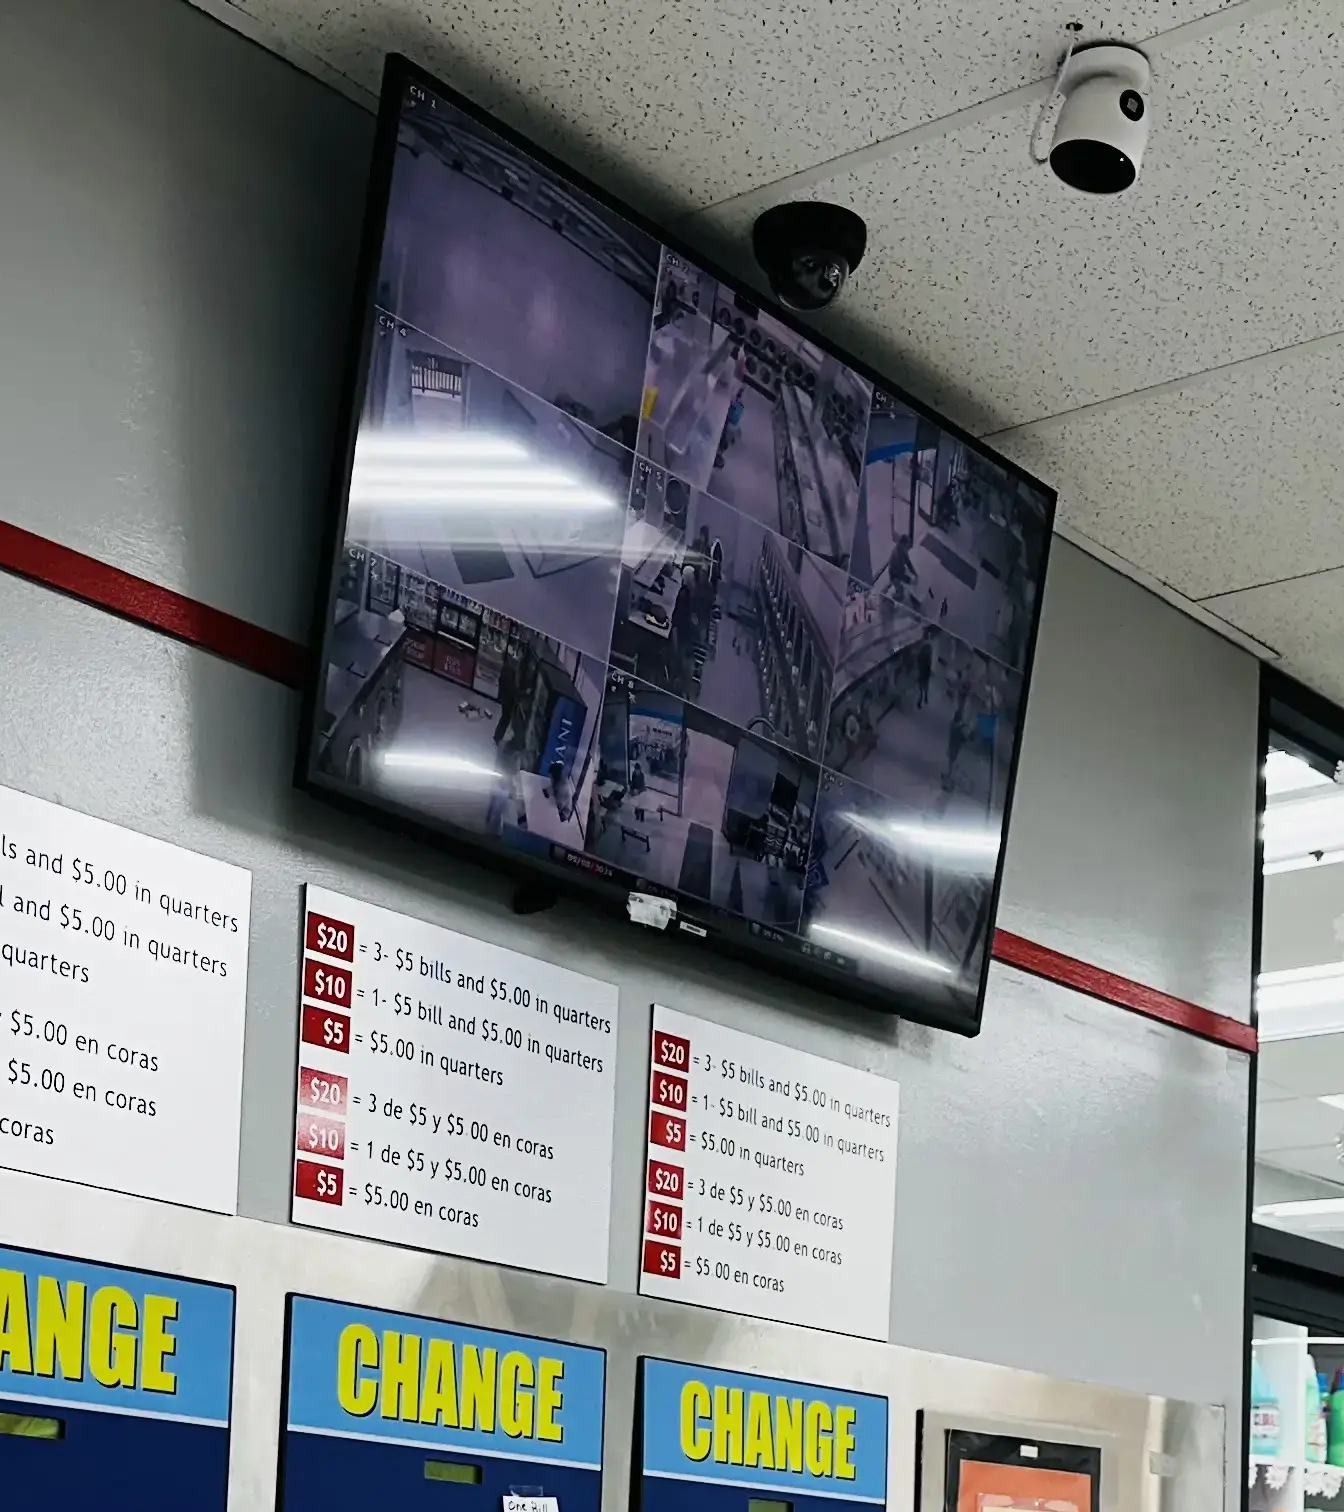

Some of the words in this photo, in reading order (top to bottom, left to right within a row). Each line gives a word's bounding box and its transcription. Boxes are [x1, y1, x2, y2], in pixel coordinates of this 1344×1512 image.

[410, 86, 424, 100] CH
[431, 100, 435, 108] 1
[379, 316, 394, 328] CH
[400, 328, 406, 336] 4
[349, 549, 364, 561] CH
[612, 672, 624, 683] CH
[26, 849, 62, 874] and
[73, 858, 126, 895] $5.00
[135, 881, 151, 905] in
[160, 895, 237, 932] quarters
[2, 944, 88, 982] quarters
[14, 896, 50, 920] and
[60, 904, 114, 940] $5.00
[123, 927, 139, 950] in
[149, 940, 226, 977] quarters
[317, 922, 347, 952] $20
[374, 942, 388, 961] 3-
[396, 948, 413, 971] $5
[420, 956, 451, 983] bills
[458, 974, 484, 994] and
[491, 978, 530, 1007] $5.00
[535, 992, 547, 1014] in
[554, 1005, 610, 1033] quarters
[11, 1009, 67, 1045] $5.00
[76, 1036, 98, 1054] en
[108, 1044, 158, 1071] coras
[315, 969, 345, 998] $10
[373, 989, 386, 1006] 1-
[395, 993, 411, 1015] $5
[418, 1001, 442, 1025] bill
[449, 1015, 475, 1035] and
[482, 1019, 522, 1048] $5.00
[528, 1033, 540, 1054] in
[546, 1045, 602, 1072] quarters
[324, 1018, 343, 1044] $5
[371, 1030, 414, 1060] $5.00
[420, 1046, 434, 1067] in
[441, 1056, 503, 1085] quarters
[9, 1058, 64, 1093] $5.00
[73, 1083, 95, 1101] en
[105, 1091, 156, 1116] coras
[0, 1118, 53, 1144] coras
[656, 1168, 678, 1192] $20
[699, 1179, 705, 1195] 3
[710, 1183, 725, 1200] de
[730, 1186, 743, 1205] $5
[748, 1196, 754, 1211] y
[760, 1194, 791, 1217] $5.00
[796, 1208, 809, 1220] en
[814, 1212, 843, 1230] coras
[337, 1323, 564, 1443] CHANGE
[679, 1380, 856, 1480] CHANGE
[509, 1501, 527, 1511] One
